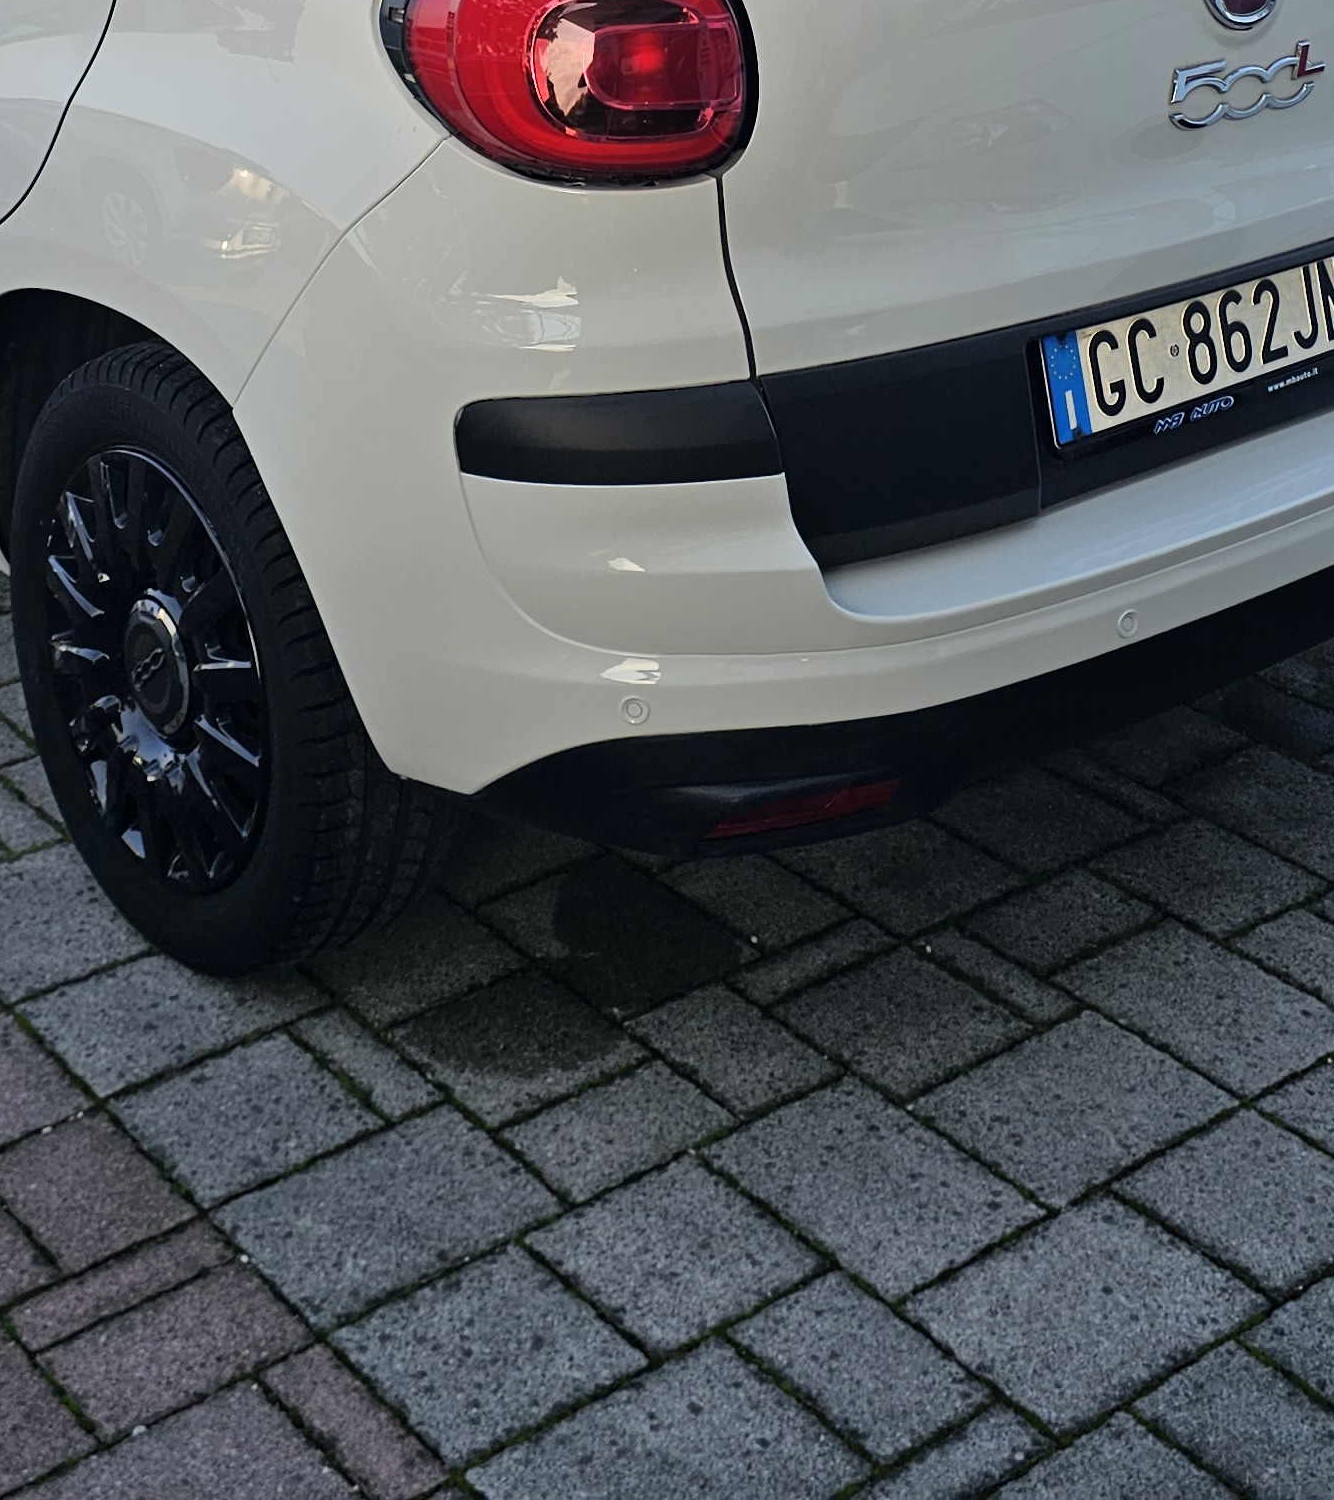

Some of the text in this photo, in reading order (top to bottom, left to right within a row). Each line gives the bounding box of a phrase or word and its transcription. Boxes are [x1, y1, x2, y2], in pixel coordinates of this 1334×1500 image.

[1169, 39, 1326, 131] 500L
[1267, 367, 1319, 393] www.mbauto.it
[1153, 395, 1235, 436] MB AUTO
